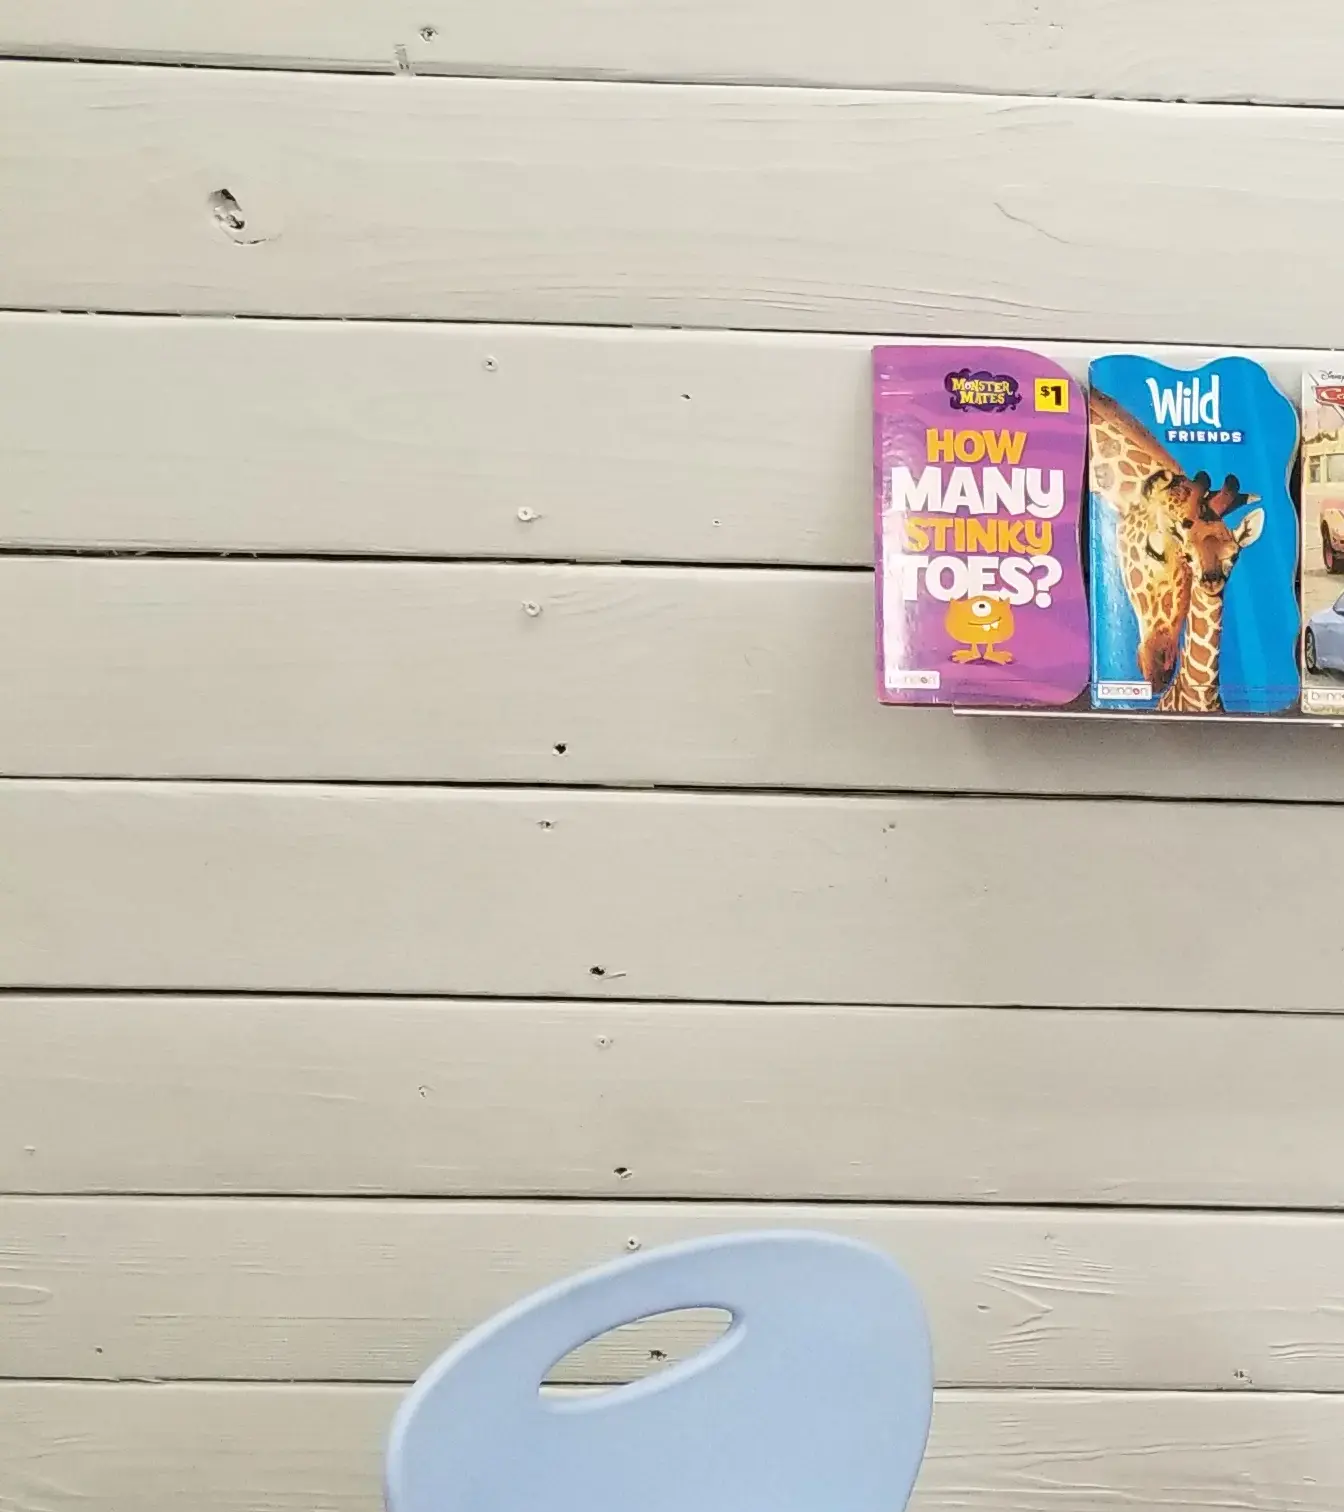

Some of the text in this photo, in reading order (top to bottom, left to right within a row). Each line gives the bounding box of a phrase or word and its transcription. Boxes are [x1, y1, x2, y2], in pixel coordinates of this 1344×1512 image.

[951, 377, 1013, 395] MONSTER
[960, 390, 1005, 405] MATES
[1040, 385, 1062, 406] $1
[1146, 374, 1223, 428] Wild
[926, 428, 1027, 465] HOW
[1168, 431, 1242, 444] FRIENDS
[890, 466, 1064, 518] MANY
[904, 517, 1053, 555] STINKY
[898, 556, 1062, 609] TOES?
